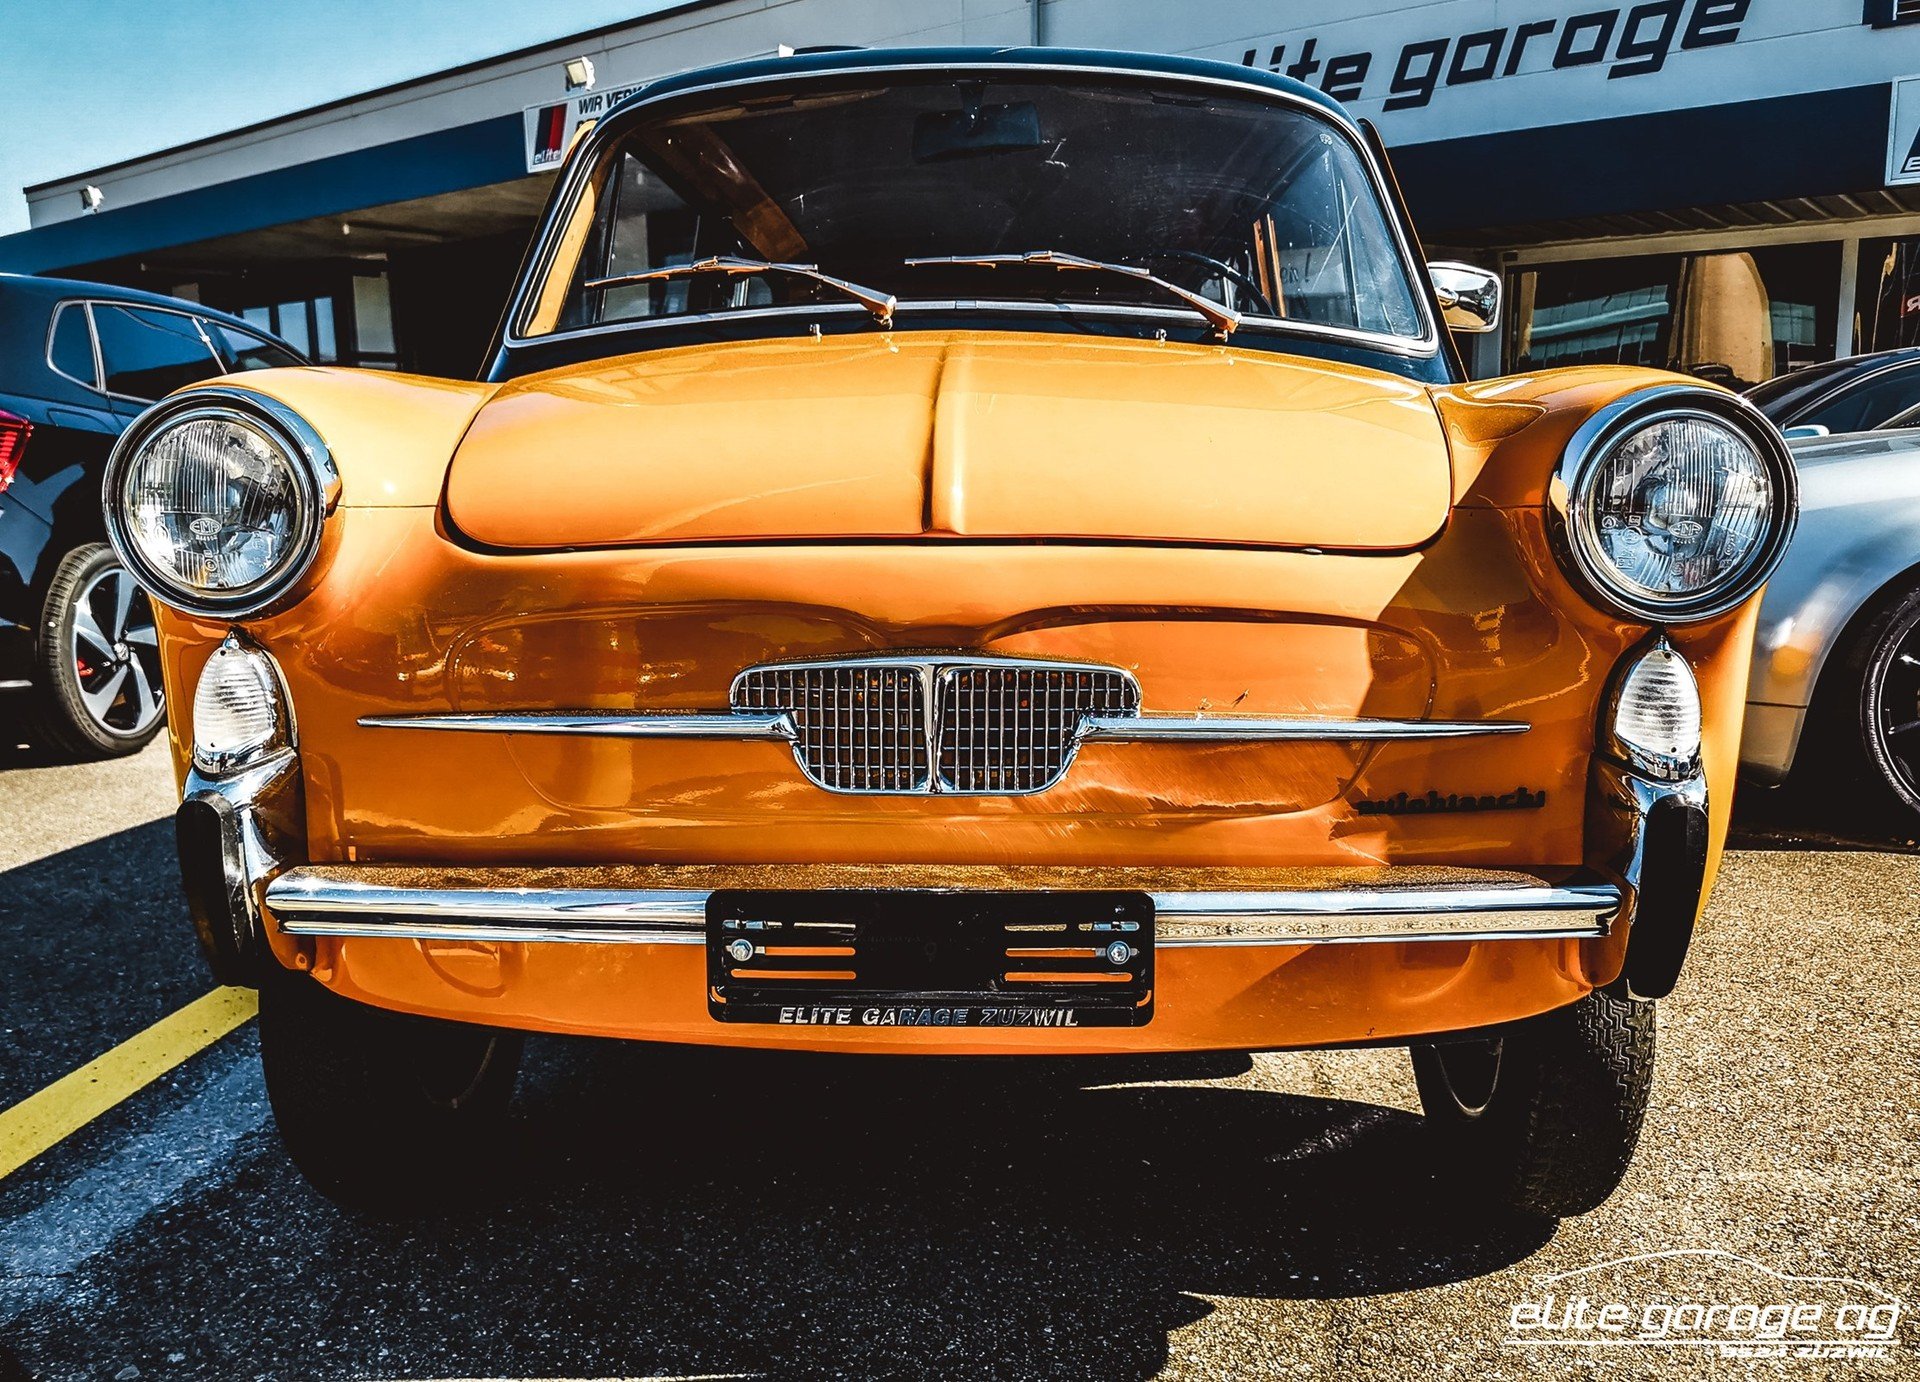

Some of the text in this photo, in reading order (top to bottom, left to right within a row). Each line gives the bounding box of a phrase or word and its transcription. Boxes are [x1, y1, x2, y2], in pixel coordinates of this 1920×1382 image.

[1382, 0, 1752, 113] garage
[579, 95, 603, 115] WIR
[534, 149, 561, 164] elite
[778, 1007, 1078, 1027] ELITE GARAGE ZUZWIL
